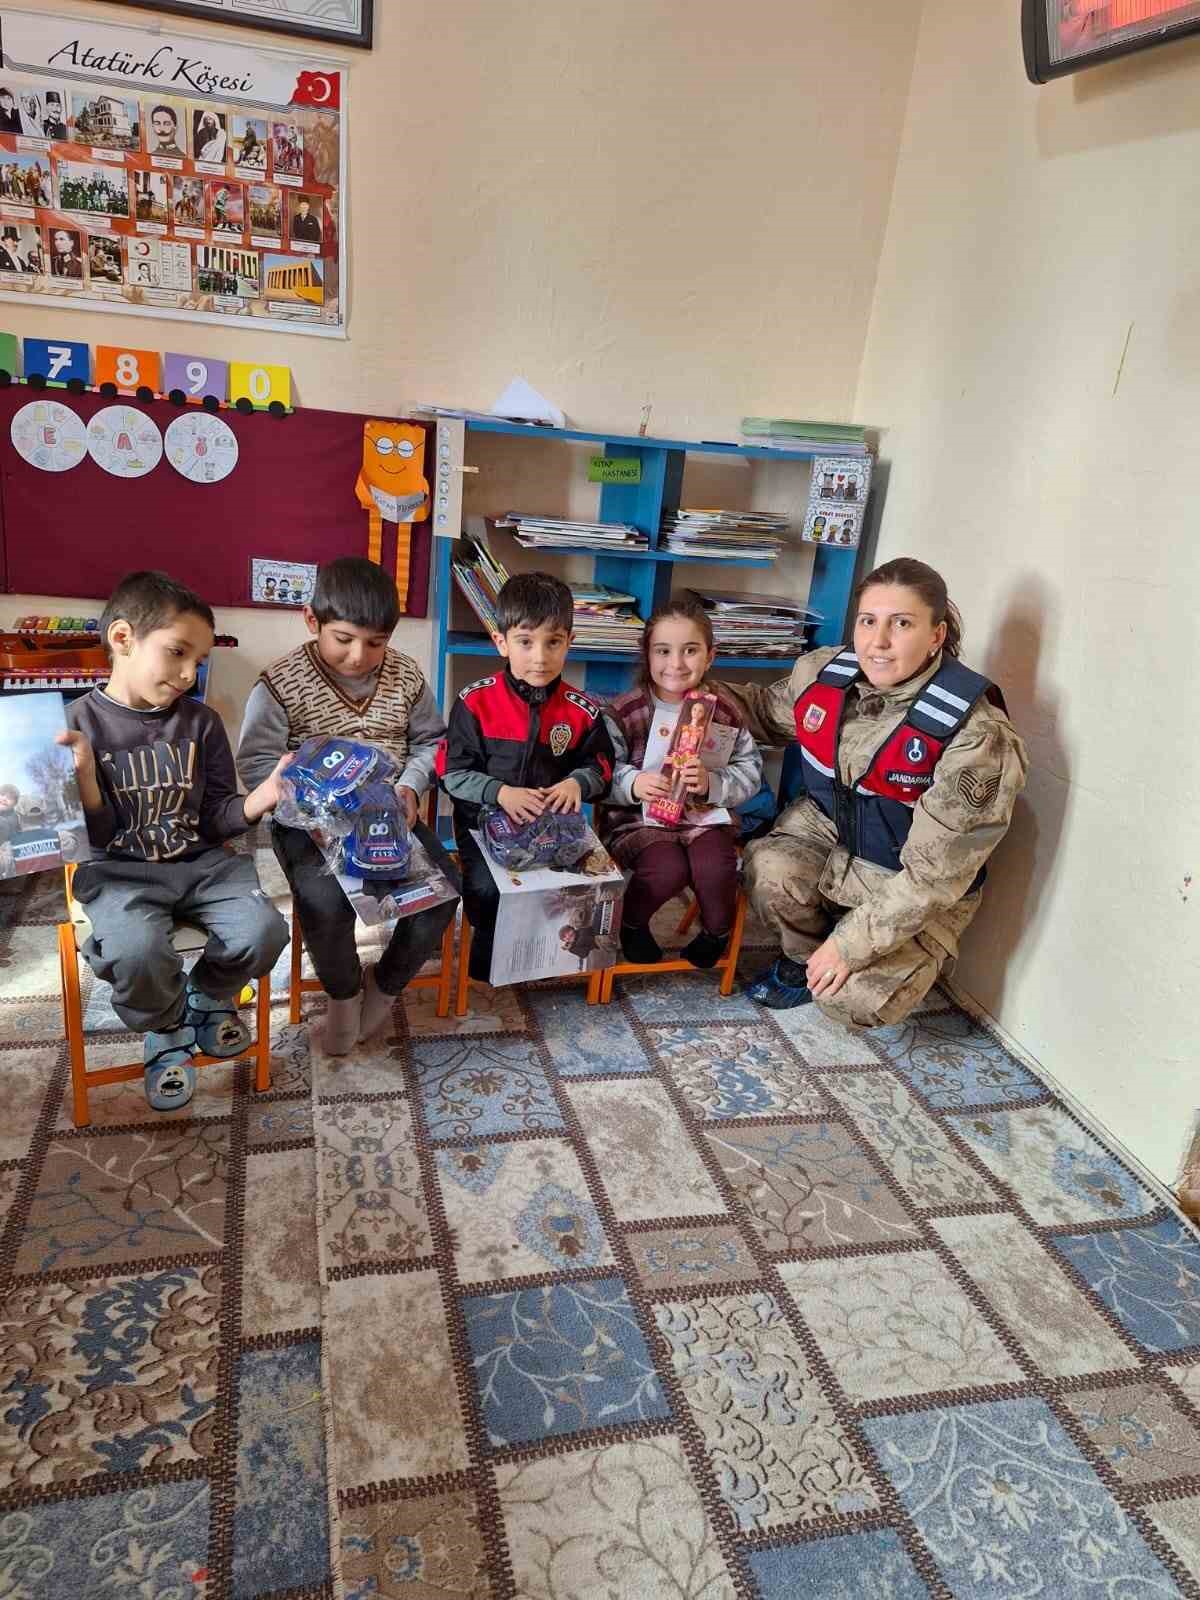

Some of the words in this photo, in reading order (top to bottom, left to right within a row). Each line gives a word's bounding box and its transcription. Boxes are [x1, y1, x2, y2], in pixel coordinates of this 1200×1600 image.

[48, 40, 173, 78] Atatürk
[171, 56, 254, 94] Köşesi
[47, 346, 72, 379] 7
[115, 353, 140, 386] 8
[185, 361, 208, 394] 9
[249, 367, 271, 401] 0
[43, 426, 57, 445] E
[117, 432, 132, 451] A
[888, 772, 932, 785] JANDARMA
